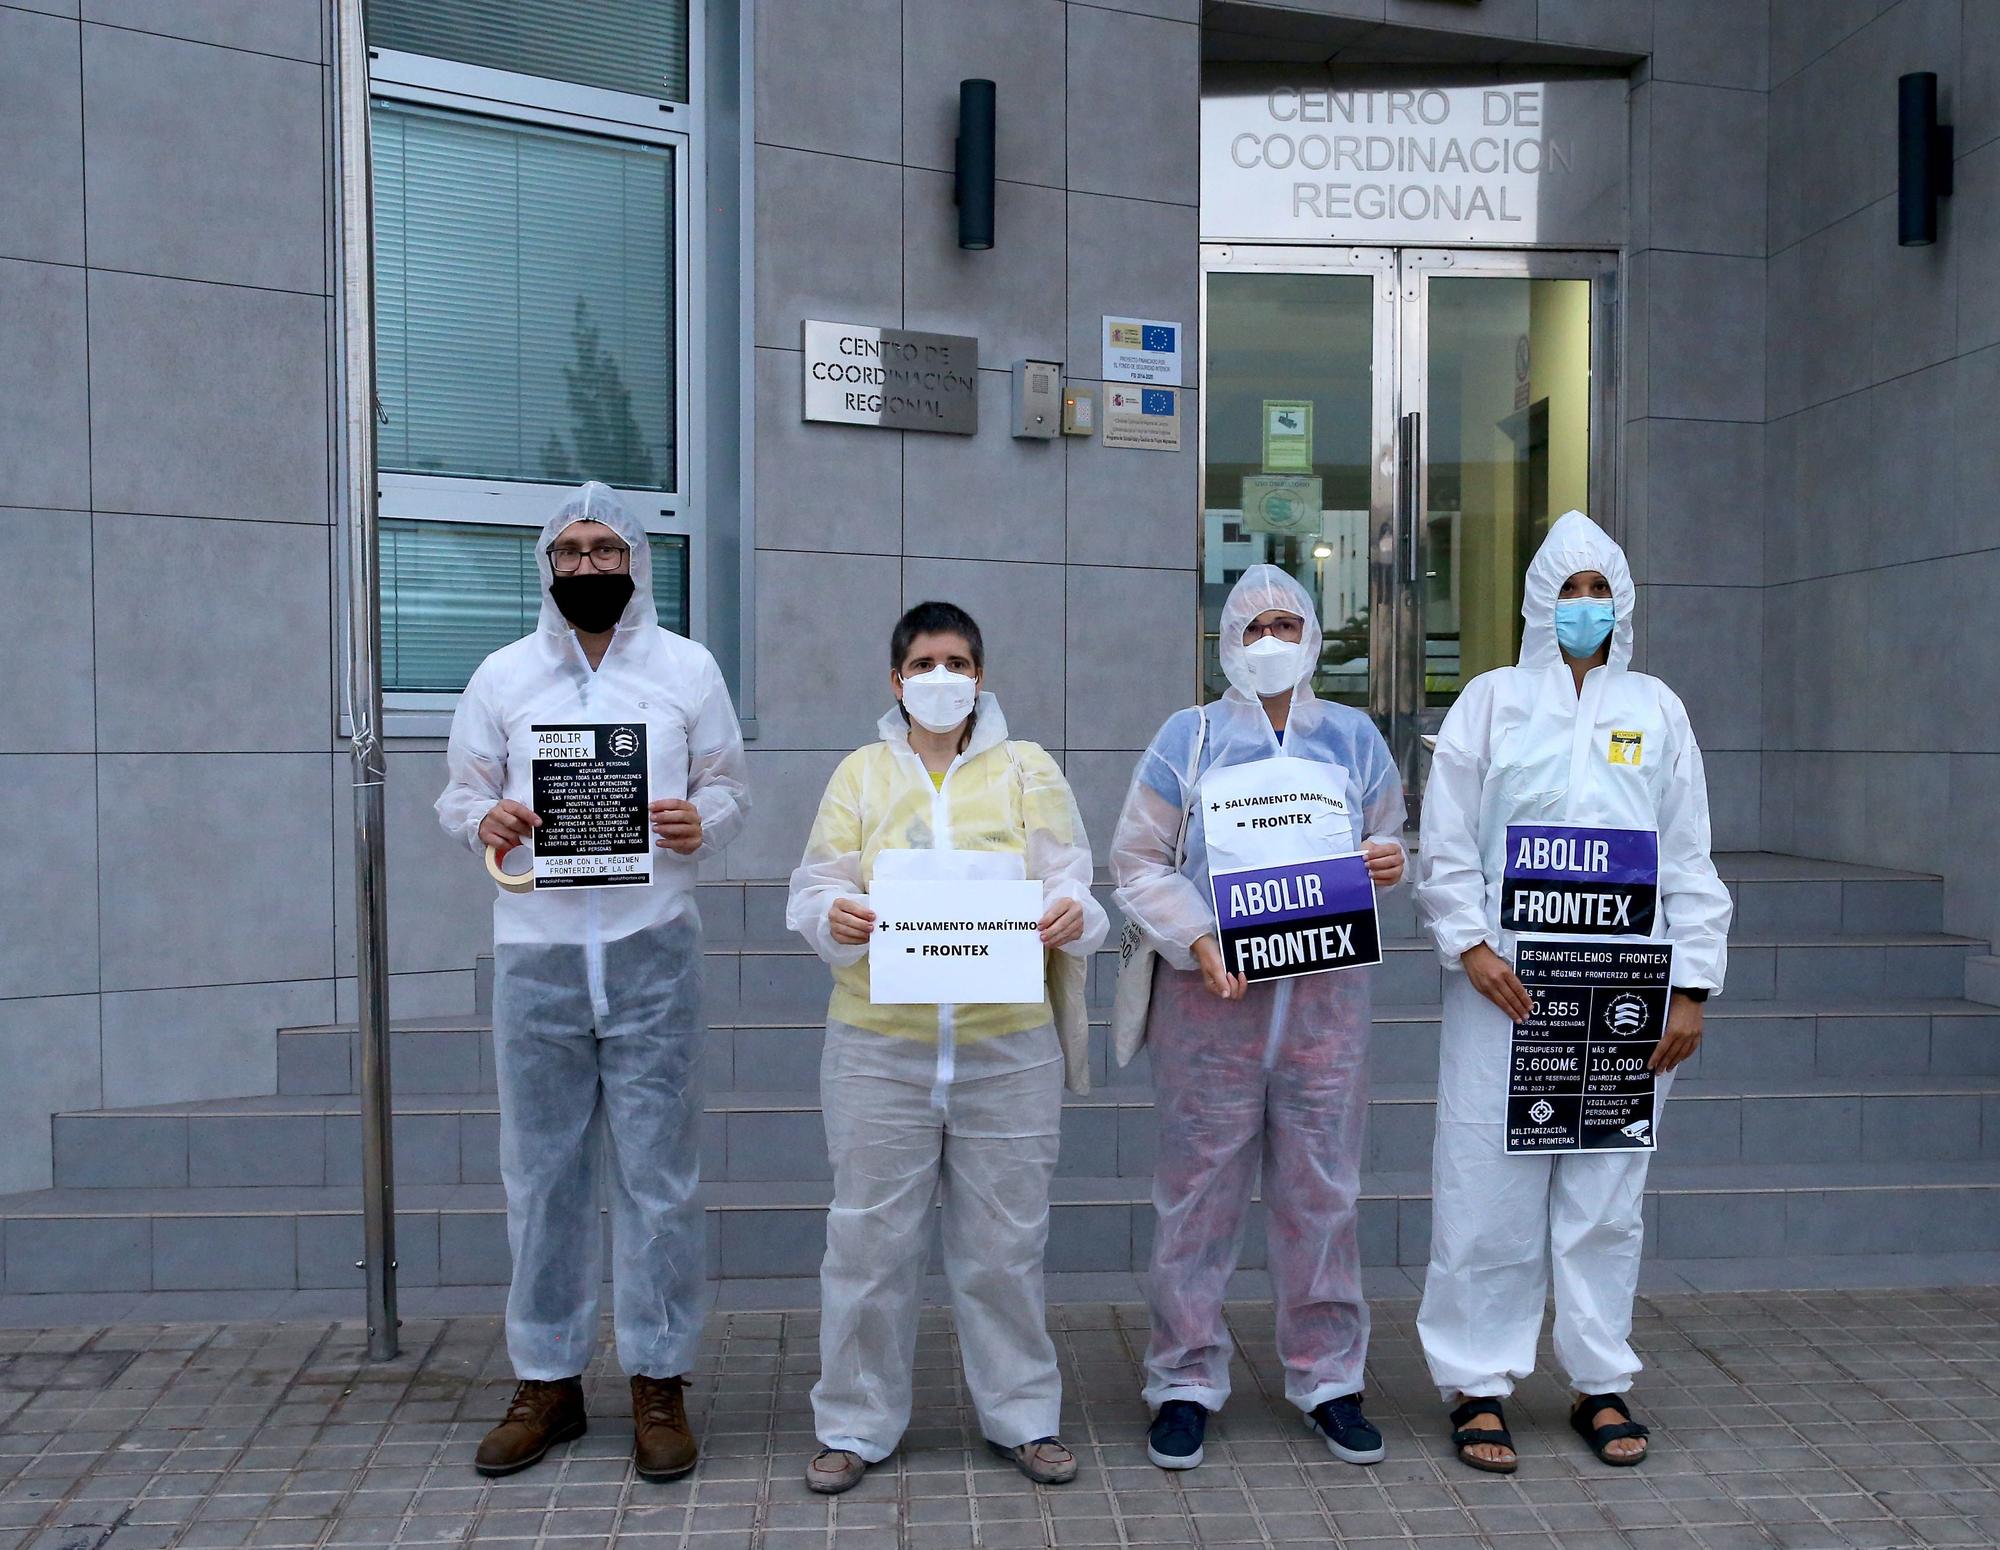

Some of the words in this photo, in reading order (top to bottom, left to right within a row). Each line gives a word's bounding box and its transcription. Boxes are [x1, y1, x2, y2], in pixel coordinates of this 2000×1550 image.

[1267, 87, 1451, 125] CENTRO
[1482, 90, 1540, 127] DE
[1230, 133, 1577, 175] COORDINACION
[1292, 182, 1523, 222] REGIONAL
[839, 337, 918, 362] CENTRO
[925, 345, 950, 365] DE
[812, 361, 973, 394] COORDINACIÓN
[845, 392, 944, 419] REGIONAL
[539, 733, 581, 743] ABOLIR
[539, 748, 589, 758] FRONTEX
[1225, 793, 1298, 810] SALVAMENTO
[1252, 814, 1312, 829] FRONTEX
[545, 858, 573, 866] ACABAR
[576, 857, 591, 865] CON
[607, 854, 640, 864] RÉGIMEN
[1514, 837, 1609, 873] ABOLIR
[549, 866, 595, 875] FRONTERIZO
[625, 864, 634, 872] UE
[1230, 874, 1325, 919] ABOLIR
[1512, 889, 1632, 927] FRONTEX
[895, 921, 974, 931] SALVAMENTO
[977, 919, 1038, 931] MARÍTIMO
[922, 945, 989, 956] FRONTEX
[1235, 923, 1356, 972] FRONTEX
[1521, 950, 1613, 963] DESMANTELEMOS
[1619, 953, 1668, 964] FRONTEX
[1520, 969, 1535, 977] FIN
[1551, 968, 1582, 978] RÉGIMEN
[1585, 971, 1628, 979] FRONTERIZO
[1656, 971, 1666, 979] UE
[1536, 990, 1546, 998] DE
[1531, 1001, 1579, 1016] 0.555
[1566, 1046, 1575, 1054] DE
[1592, 1045, 1606, 1053] MÁS
[1608, 1046, 1618, 1054] DE
[1515, 1057, 1579, 1071] 5.600M€
[1591, 1058, 1643, 1071] 10.000
[1624, 1072, 1650, 1081] ARMADOS
[1584, 1118, 1626, 1126] MOVIMIENTO
[1511, 1126, 1567, 1135] MILITARIZACIÓN
[1538, 1136, 1575, 1145] FRONTERAS
